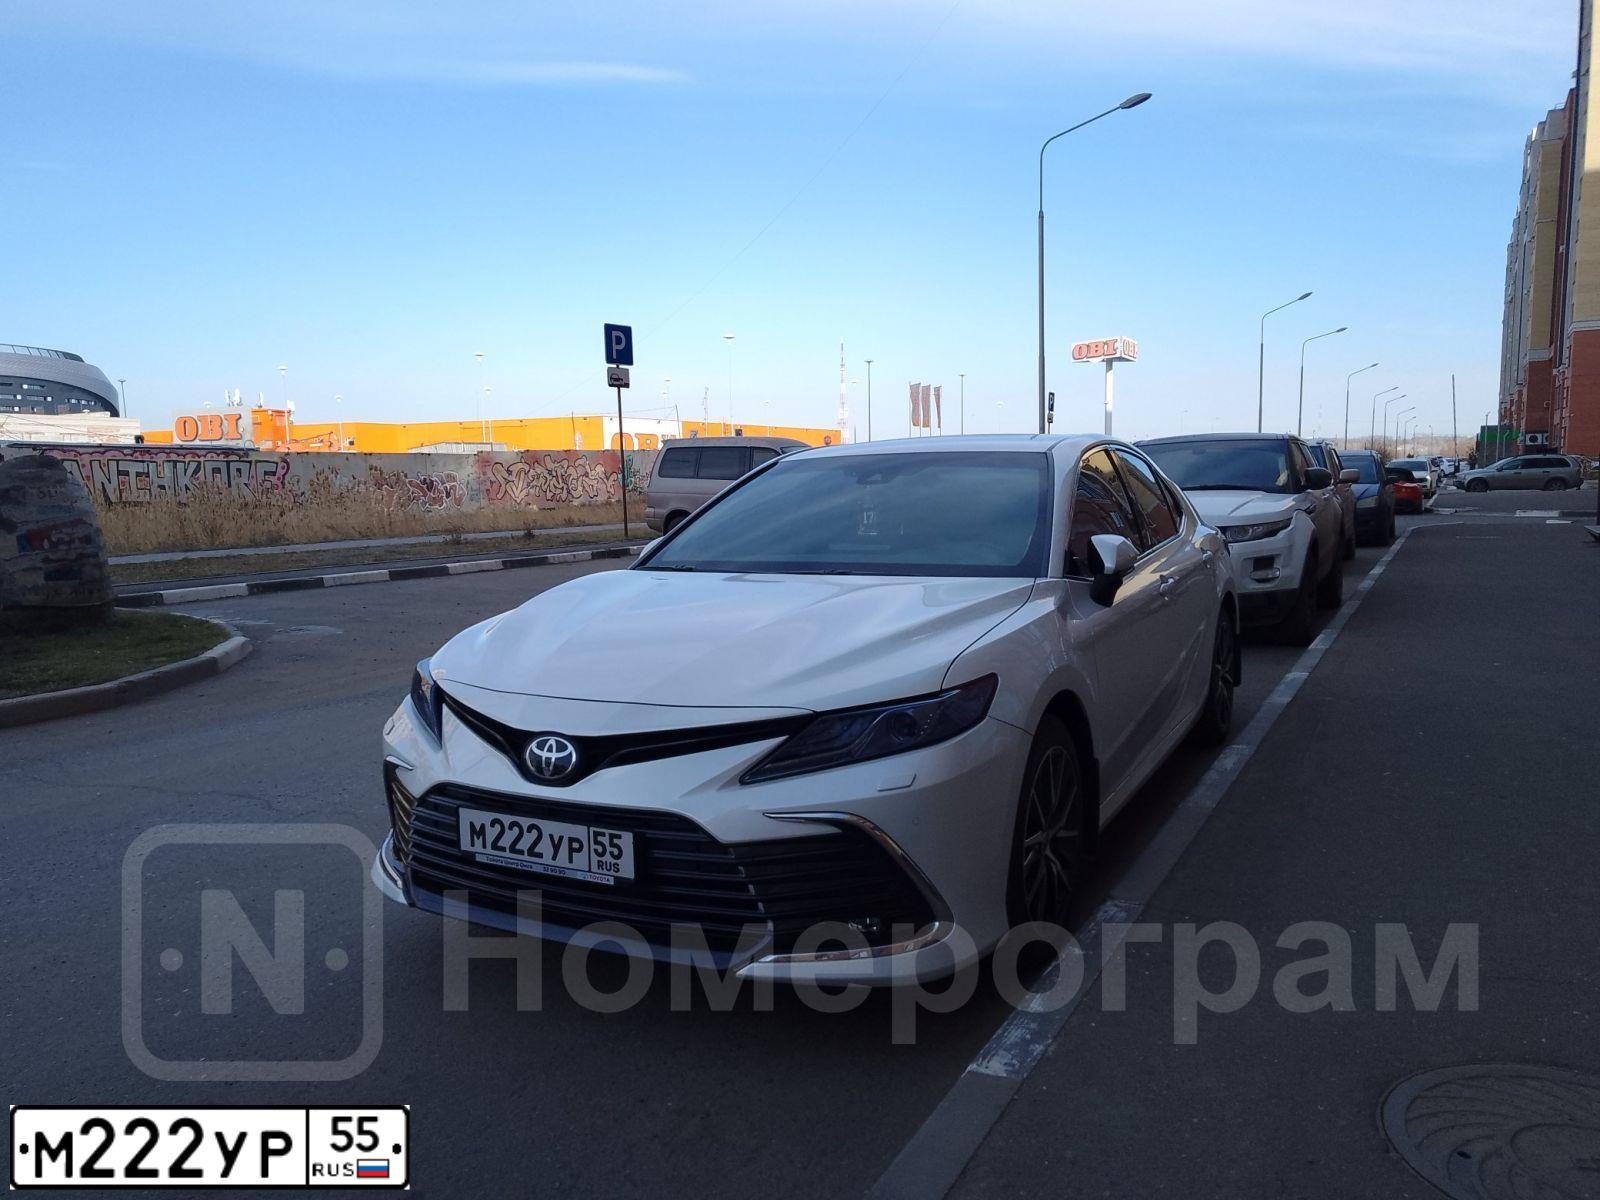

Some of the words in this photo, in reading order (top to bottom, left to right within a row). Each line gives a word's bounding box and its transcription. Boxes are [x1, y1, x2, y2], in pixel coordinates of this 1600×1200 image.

[612, 330, 626, 360] P
[1072, 339, 1118, 361] OBI
[175, 414, 242, 442] OBI
[611, 433, 676, 451] OB
[593, 831, 623, 861] 55
[597, 860, 620, 873] RUS
[589, 874, 610, 882] TOYOTA
